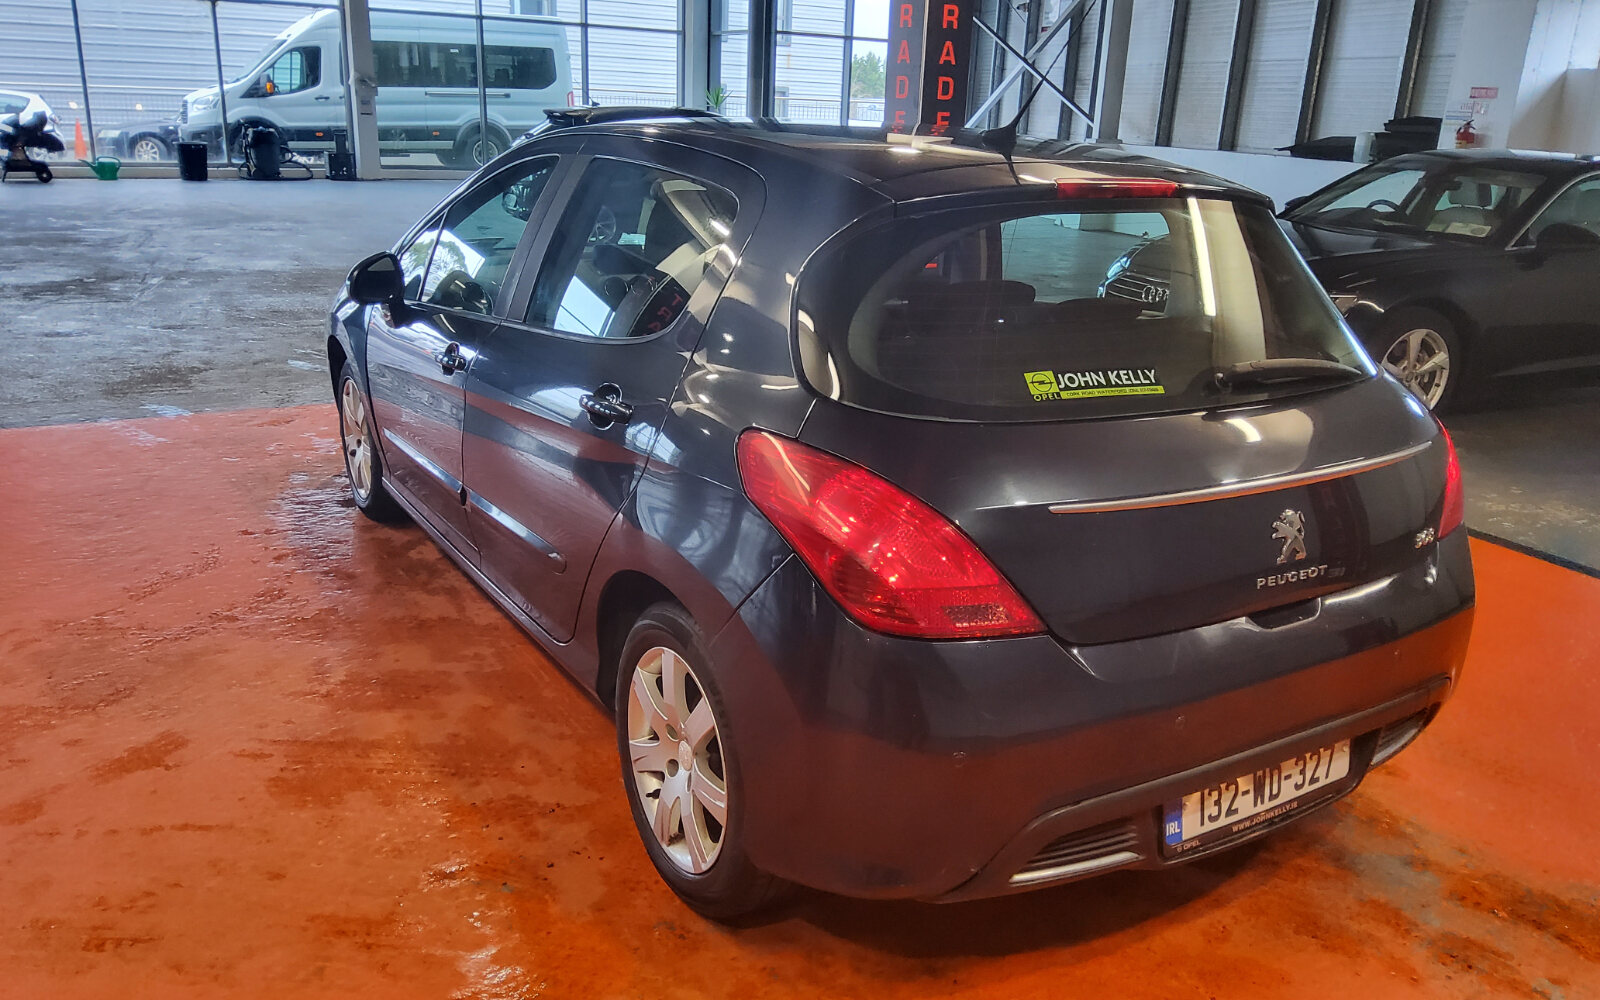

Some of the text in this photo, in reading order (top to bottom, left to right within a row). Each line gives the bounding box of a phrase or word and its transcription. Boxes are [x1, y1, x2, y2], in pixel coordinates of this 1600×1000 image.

[1057, 369, 1156, 389] JOHN KELLY
[1033, 393, 1061, 402] OPEL
[1256, 564, 1329, 590] PEUGEOT
[1199, 746, 1336, 827] 132-WD-327
[1166, 820, 1181, 837] IRL
